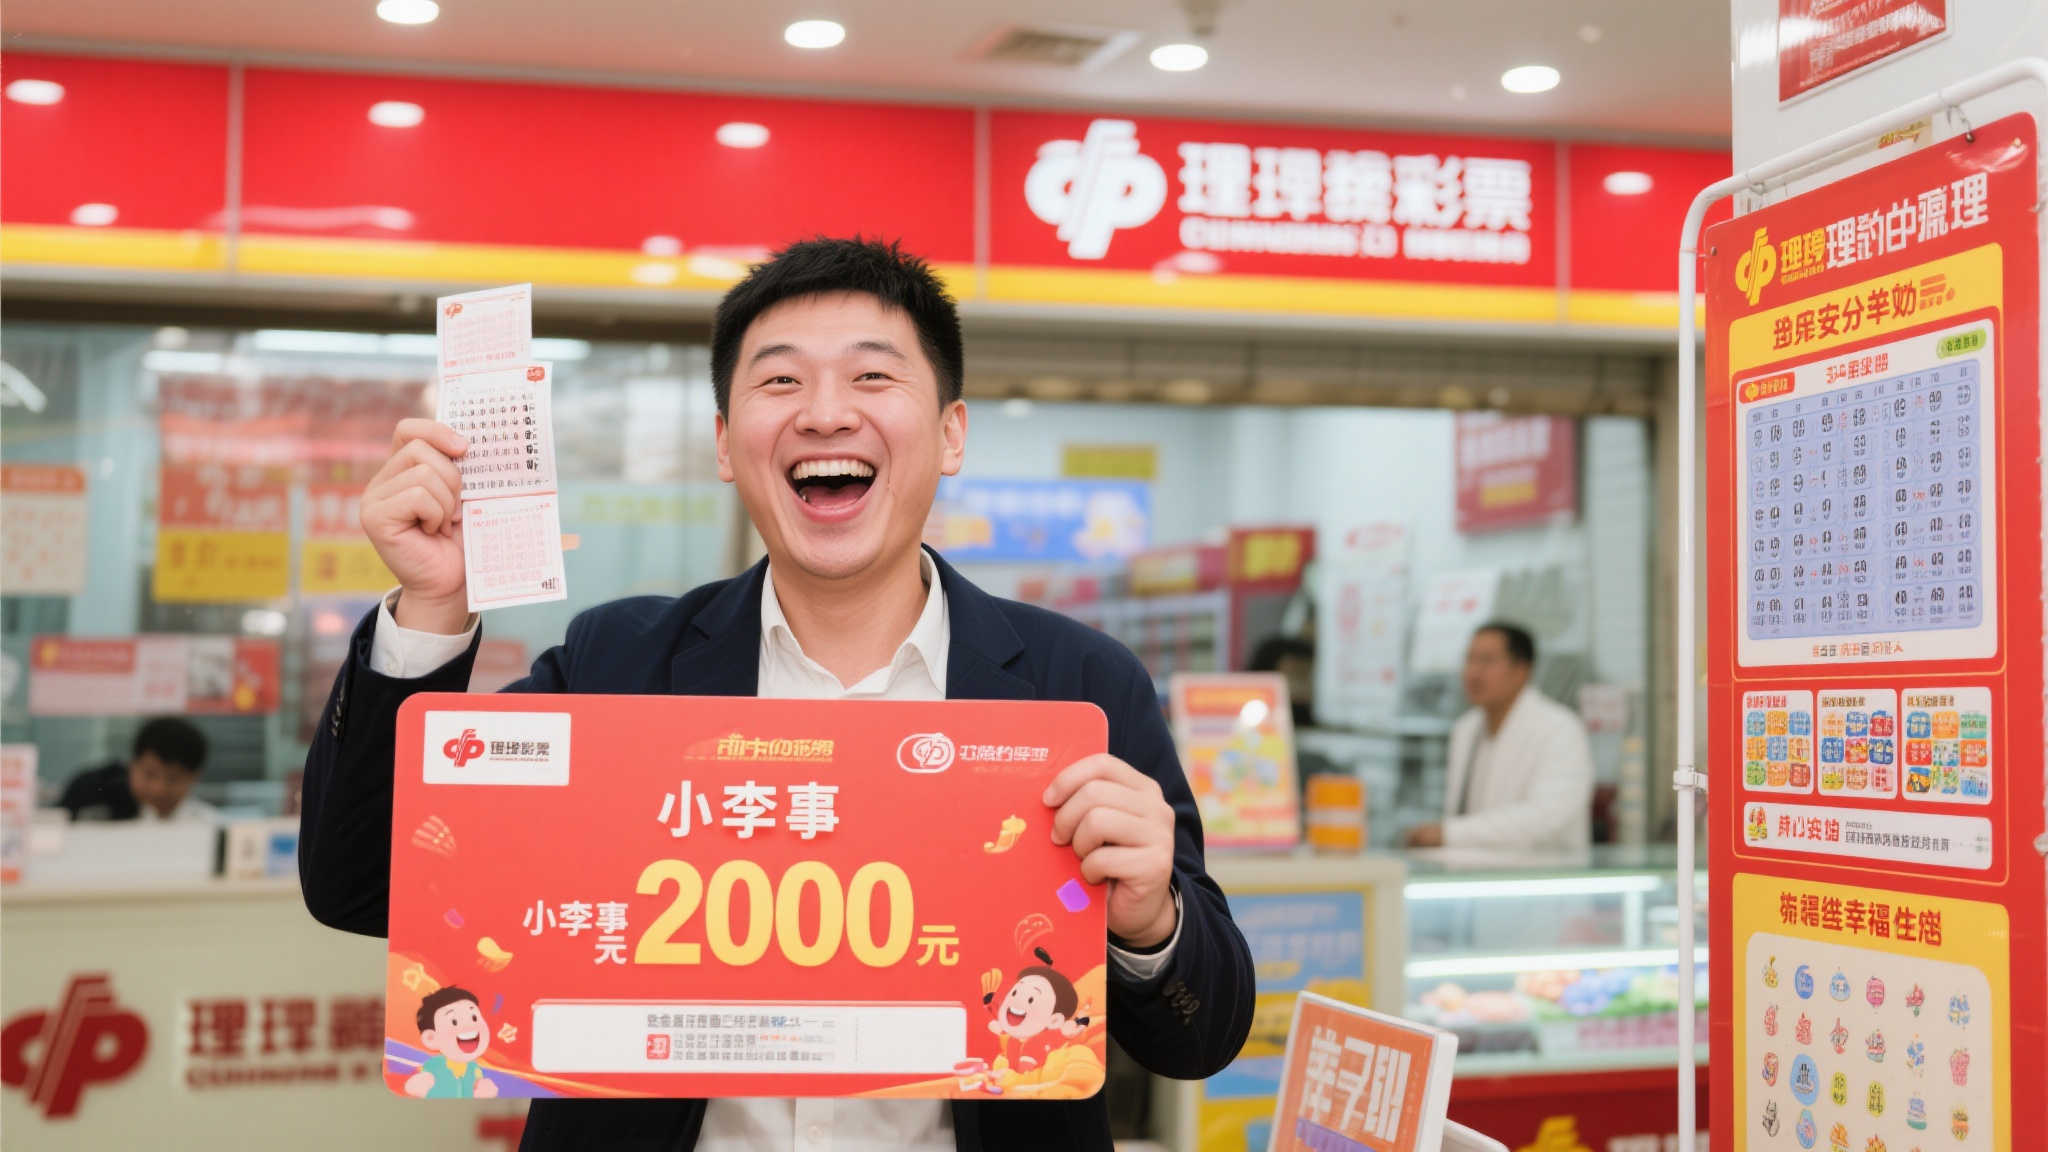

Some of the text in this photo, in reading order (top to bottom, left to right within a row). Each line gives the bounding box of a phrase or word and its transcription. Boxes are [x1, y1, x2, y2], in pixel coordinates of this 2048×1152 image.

[657, 780, 840, 839] 小李事
[522, 858, 960, 967] 小李事 2000 元
[594, 935, 629, 965] 元
